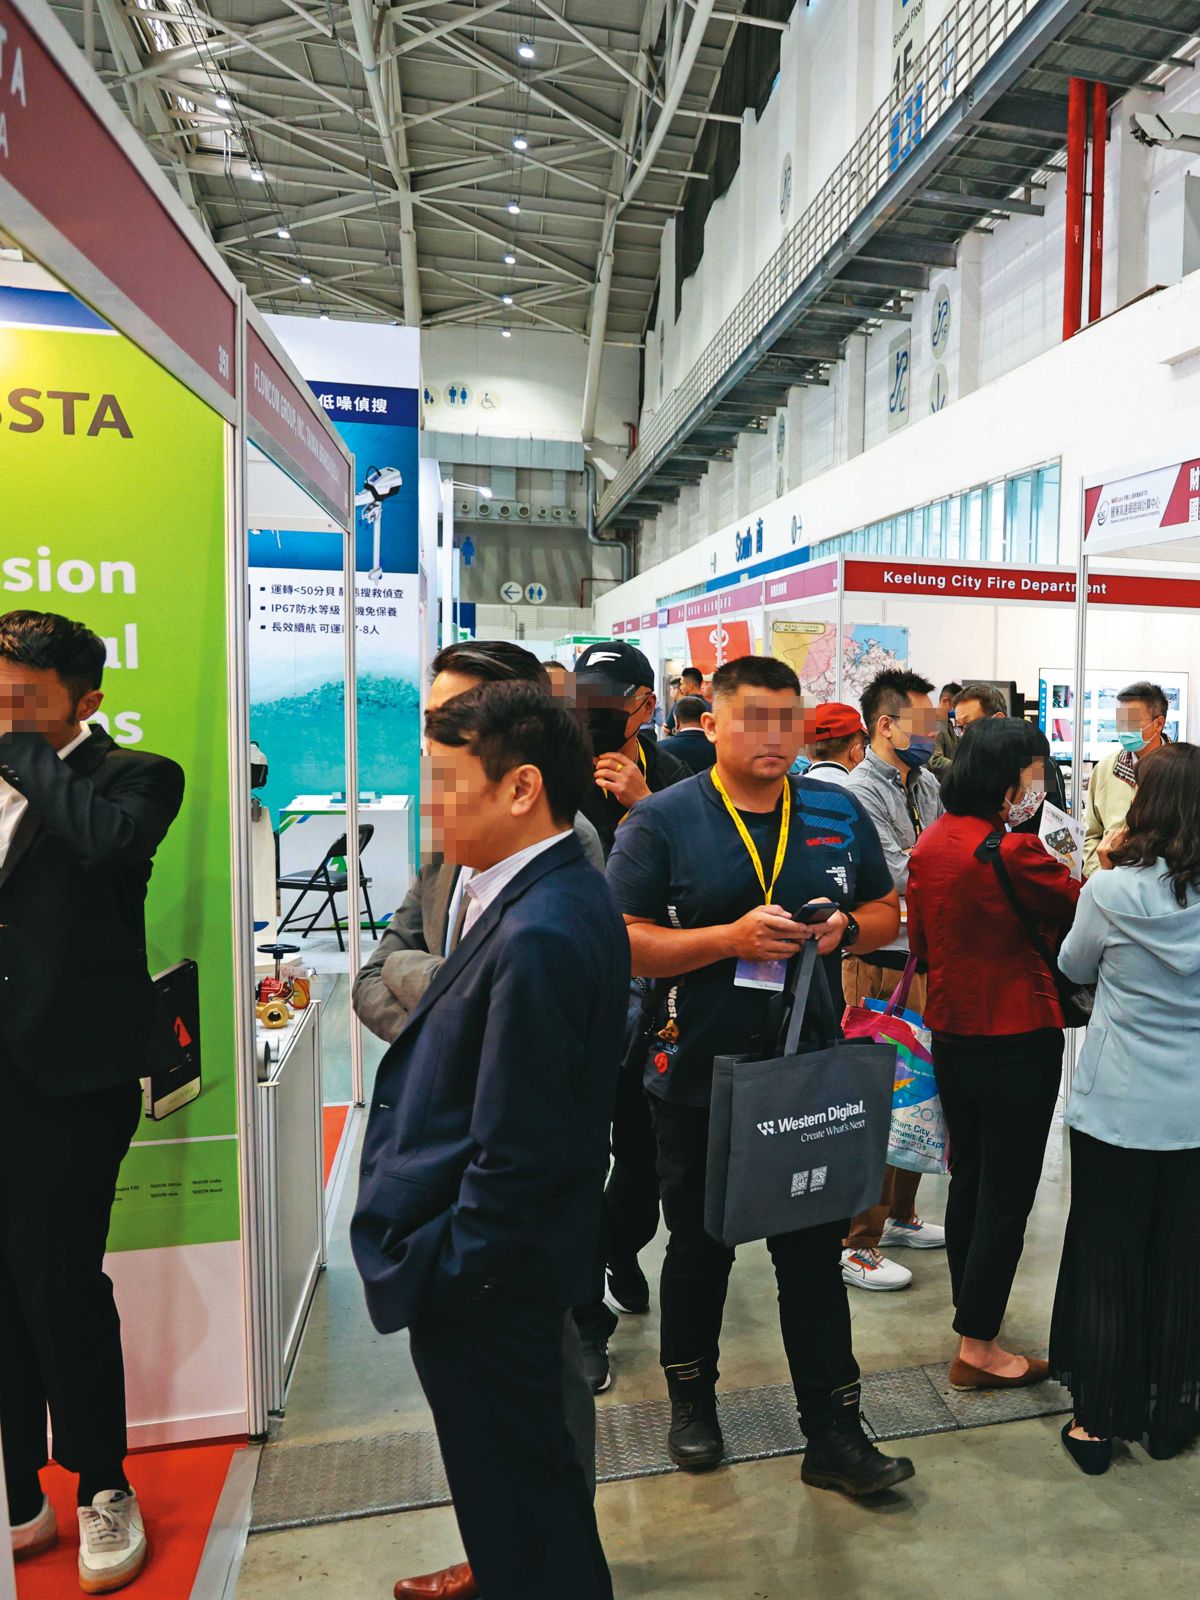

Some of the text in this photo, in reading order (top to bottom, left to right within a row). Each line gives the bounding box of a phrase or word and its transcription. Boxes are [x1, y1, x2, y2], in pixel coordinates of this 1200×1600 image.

[0, 388, 134, 439] STA
[2, 546, 136, 594] sion
[883, 570, 946, 589] Keelung
[951, 574, 982, 591] City
[987, 576, 1016, 590] Fire
[271, 604, 340, 615] IP67防水等級
[272, 622, 316, 634] 長效續航
[778, 1100, 865, 1133] Western Digital.
[801, 1119, 865, 1143] Create What's Next
[914, 1125, 930, 1137] City
[927, 1138, 945, 1149] Expo
